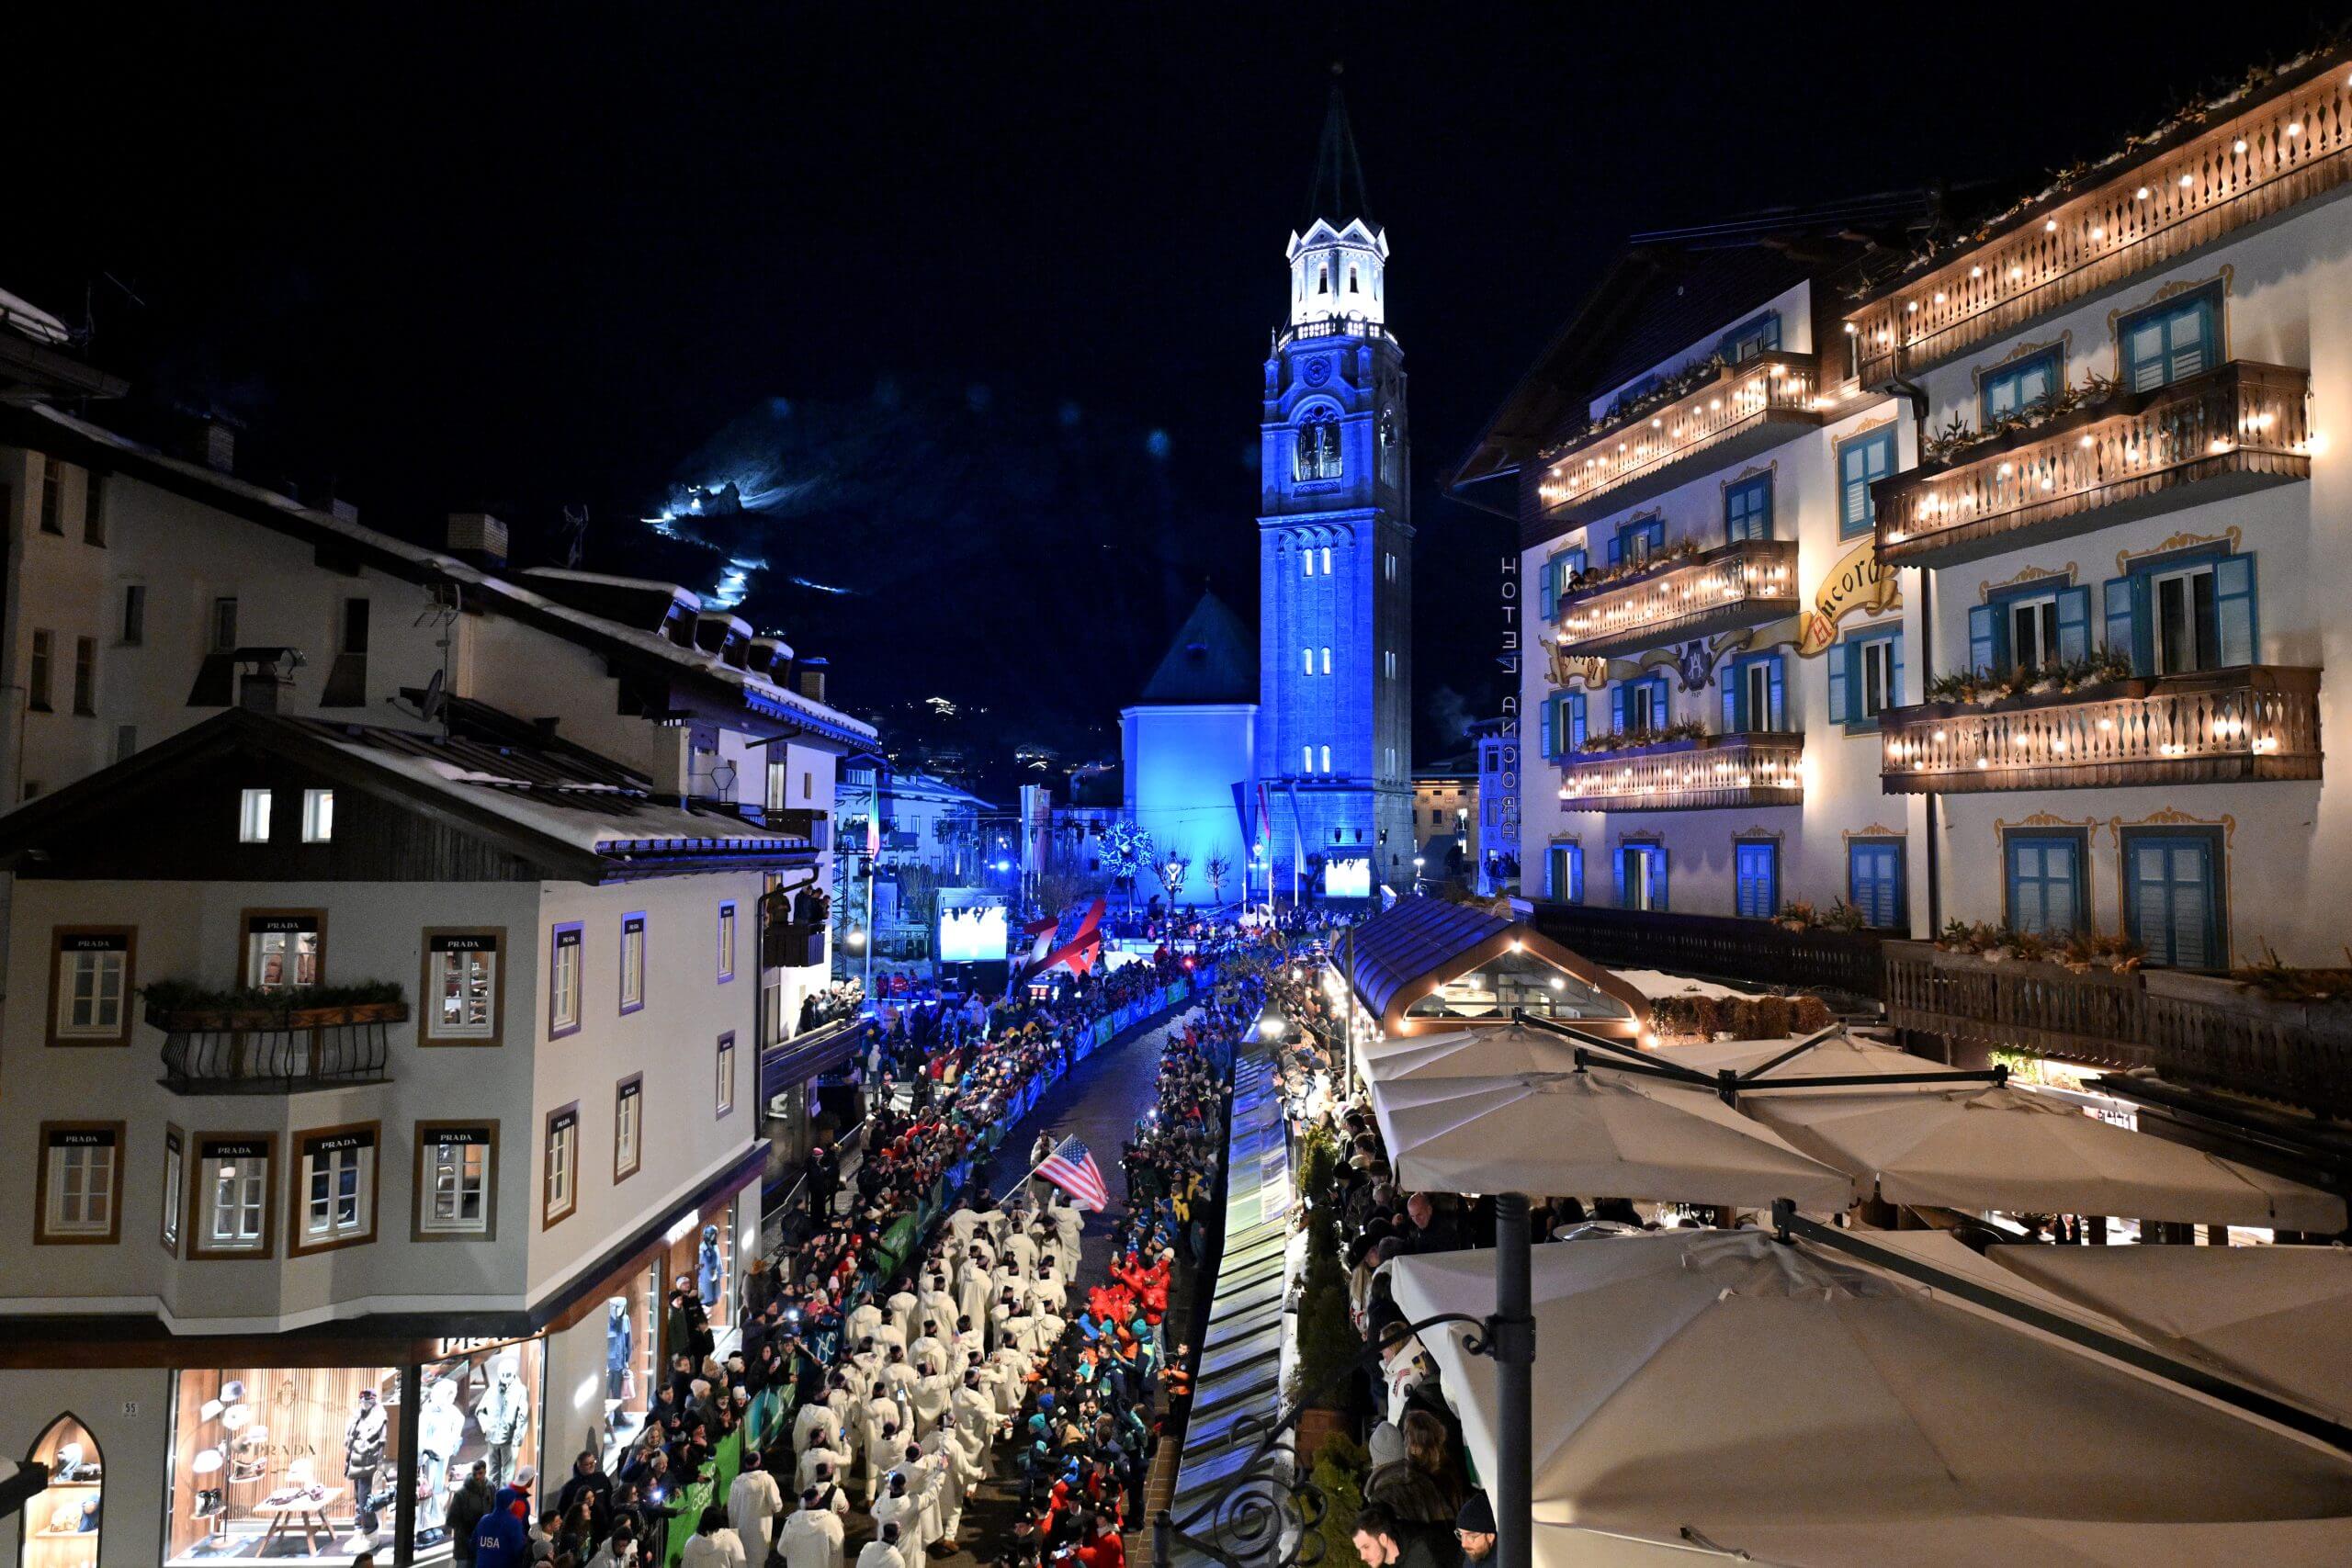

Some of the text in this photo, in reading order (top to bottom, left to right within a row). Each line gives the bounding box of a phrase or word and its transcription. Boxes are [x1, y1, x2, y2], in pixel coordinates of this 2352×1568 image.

[322, 1138, 357, 1150] PRADA
[254, 1443, 316, 1456] PRADA
[480, 1535, 500, 1549] USA
